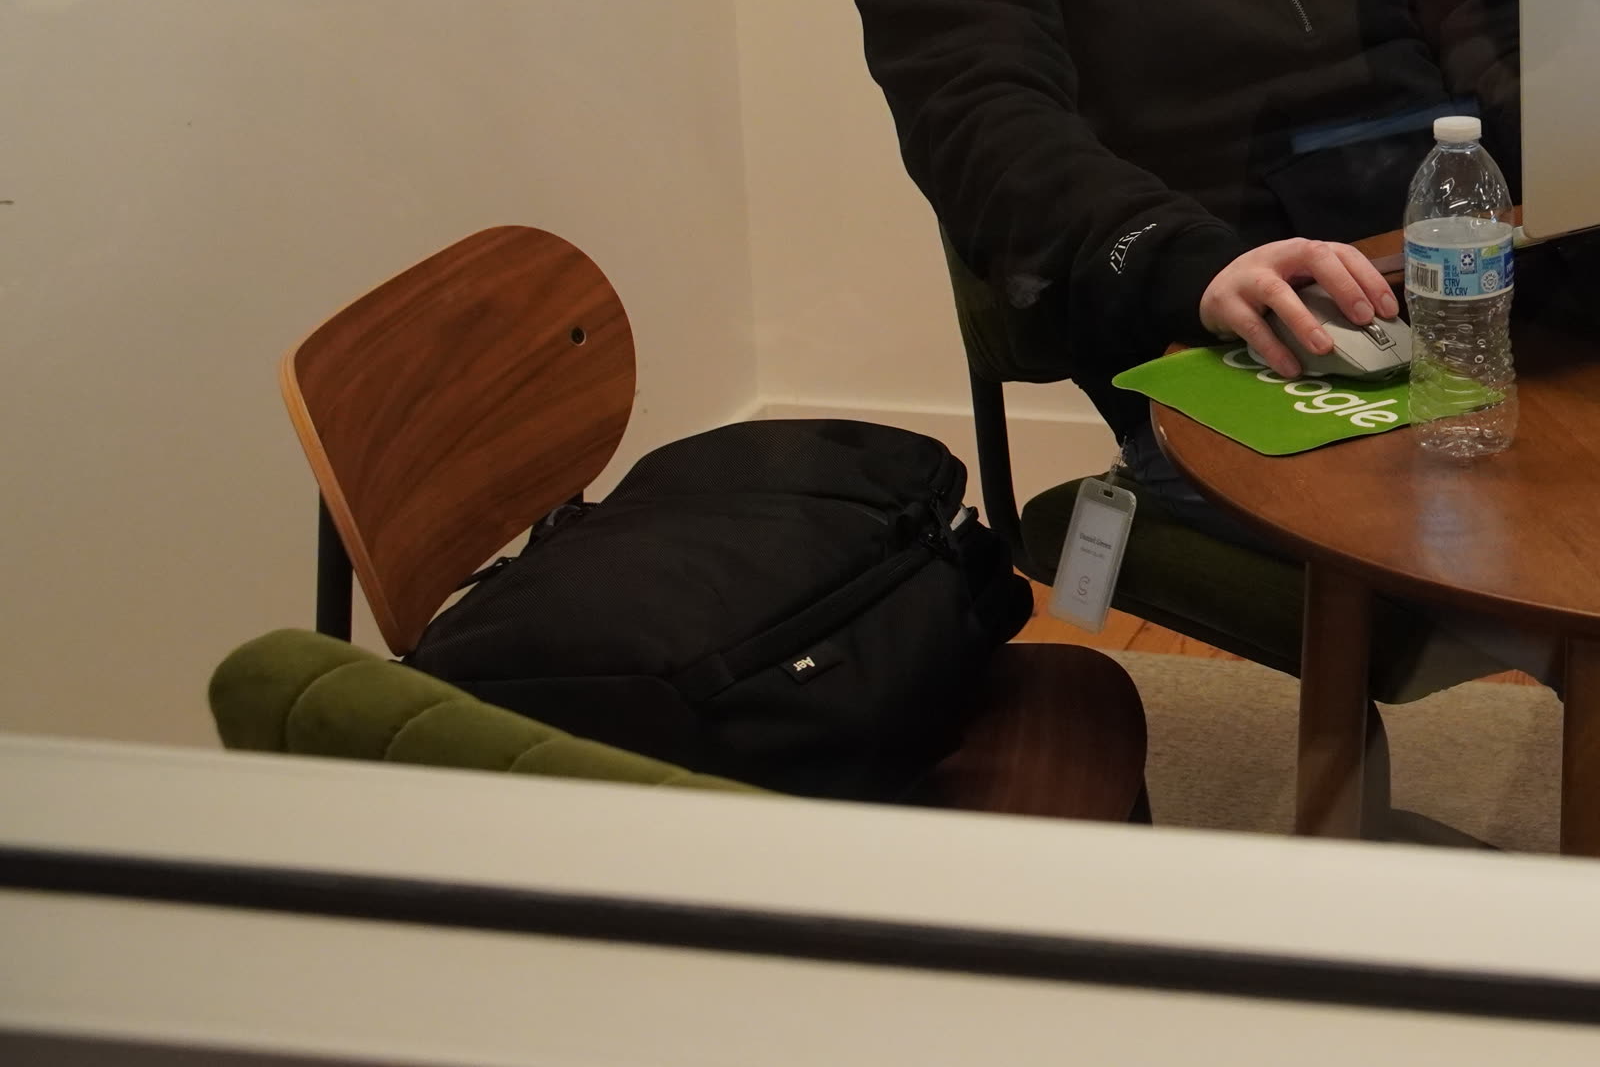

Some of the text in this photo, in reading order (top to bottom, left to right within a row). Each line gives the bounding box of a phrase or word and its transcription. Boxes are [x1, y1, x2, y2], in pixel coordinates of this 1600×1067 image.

[1443, 286, 1454, 296] CA
[1454, 286, 1469, 296] CRV
[792, 656, 816, 672] Aer
